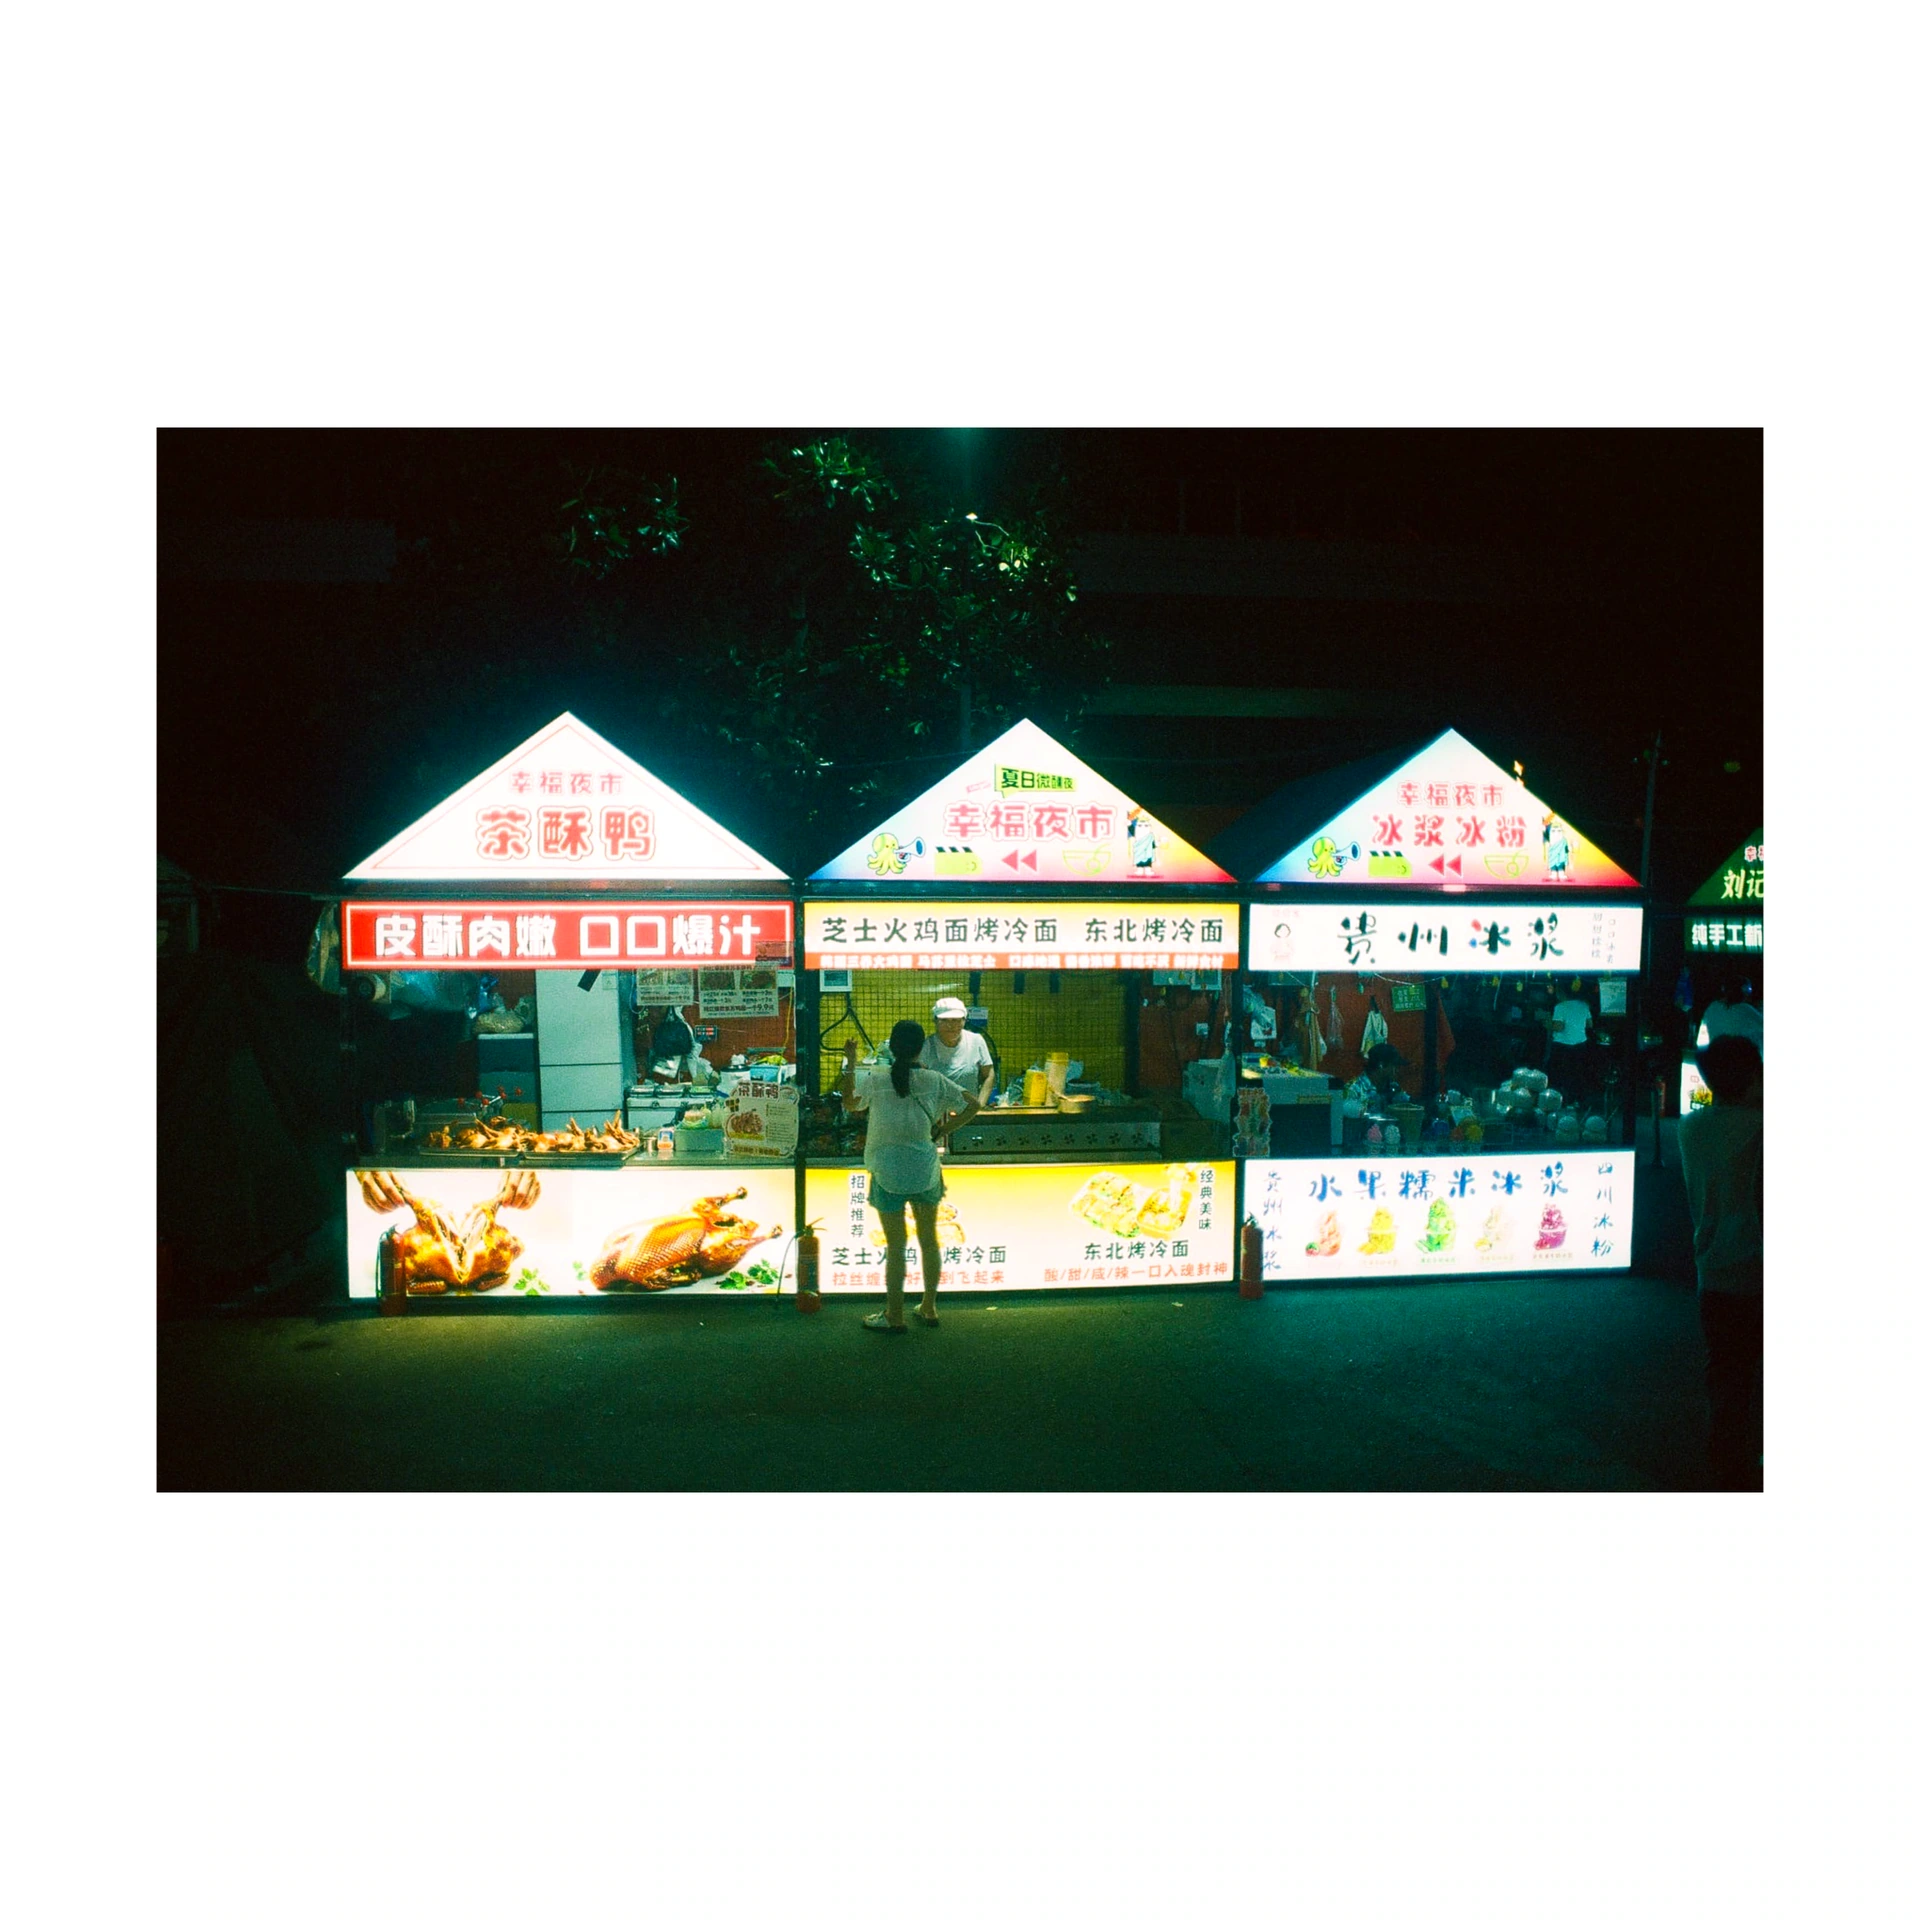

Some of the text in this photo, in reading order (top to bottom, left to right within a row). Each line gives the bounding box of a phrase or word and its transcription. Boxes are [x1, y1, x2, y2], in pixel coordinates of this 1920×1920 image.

[511, 771, 623, 795] 幸福夜市
[1398, 781, 1506, 807] 幸福夜市
[477, 807, 655, 861] 茶酥鸭
[944, 802, 1118, 841] 幸福夜市
[1372, 814, 1527, 848] 冰浆冰粉
[375, 914, 557, 957] 皮酥肉嫩
[579, 914, 760, 957] 口口爆汁
[822, 917, 1223, 943] 芝士火鸡面烤冷面 东北烤冷面
[1337, 911, 1564, 965] 贵州冰浆
[1198, 1169, 1213, 1230] 经典美味
[1309, 1161, 1568, 1201] 水果糯米冰浆
[851, 1175, 866, 1238] 招牌推荐
[1591, 1162, 1614, 1257] 四川冰粉
[832, 1245, 1007, 1266] 芝士火鸡烤冷面
[1084, 1240, 1189, 1260] 东北烤冷面
